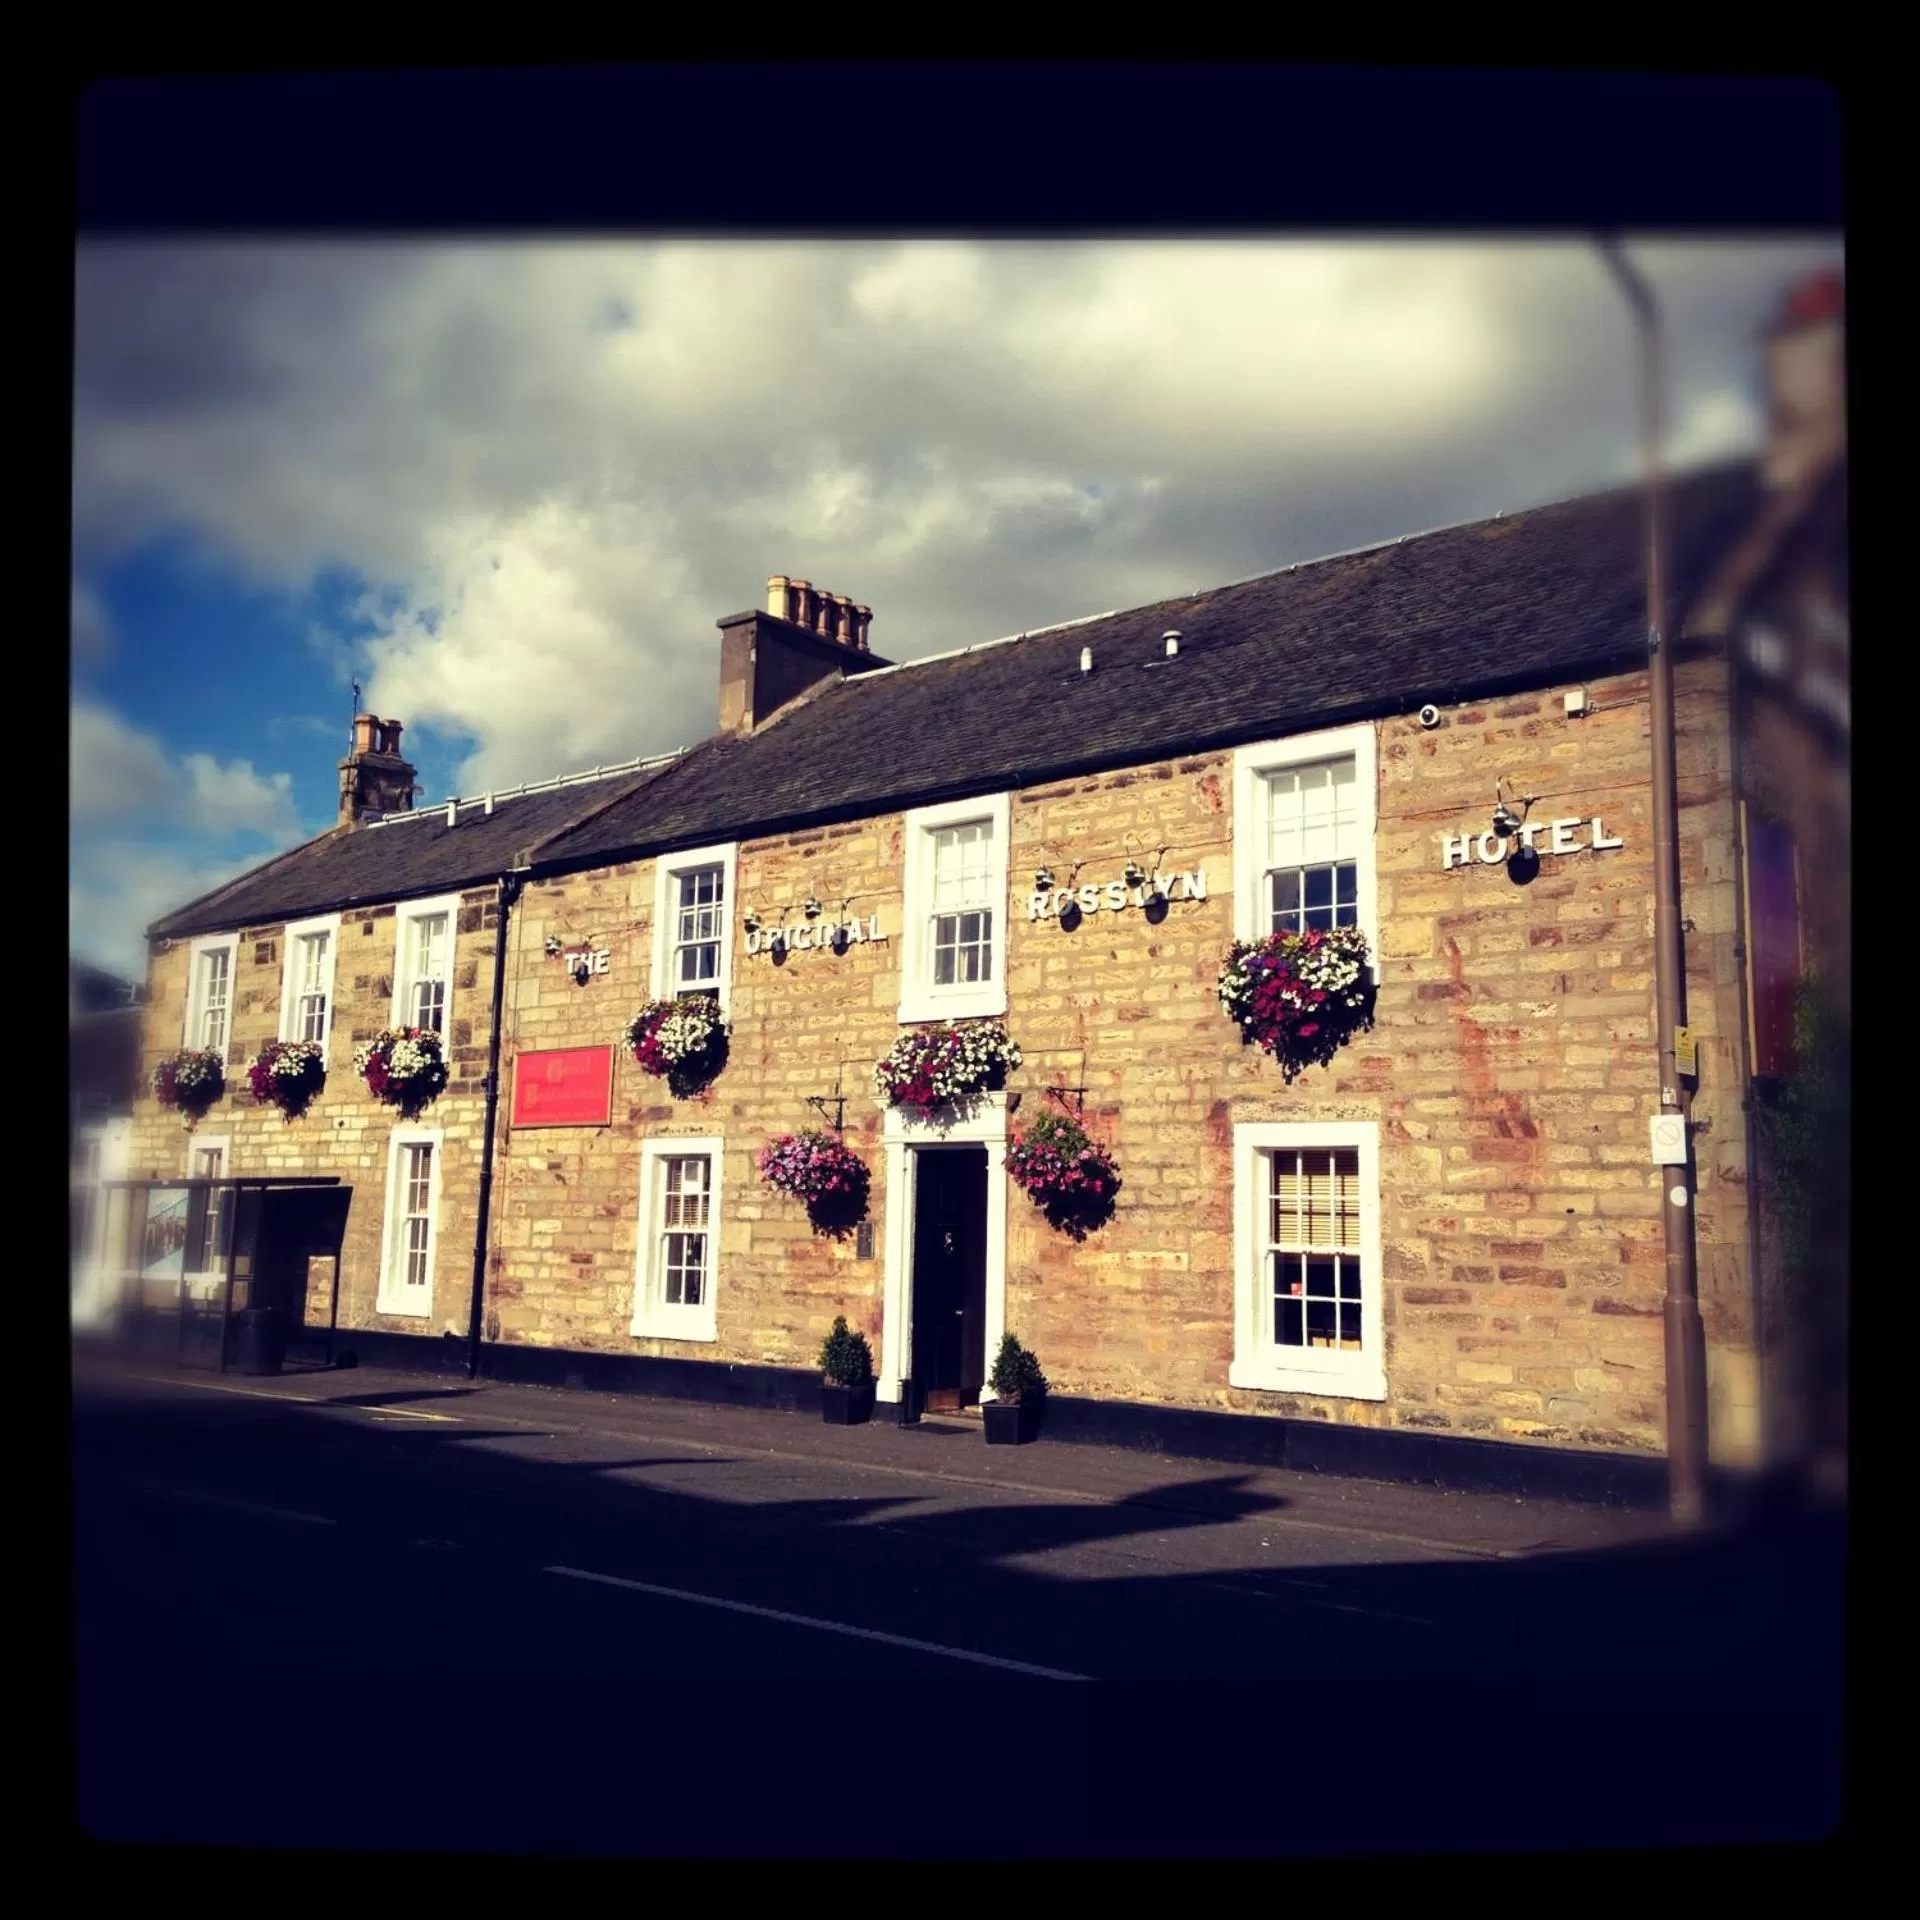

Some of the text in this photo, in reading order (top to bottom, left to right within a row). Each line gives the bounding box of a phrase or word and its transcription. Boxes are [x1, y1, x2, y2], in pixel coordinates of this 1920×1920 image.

[564, 817, 1624, 975] THE ORIGINAL ROSSLYN HOTEL
